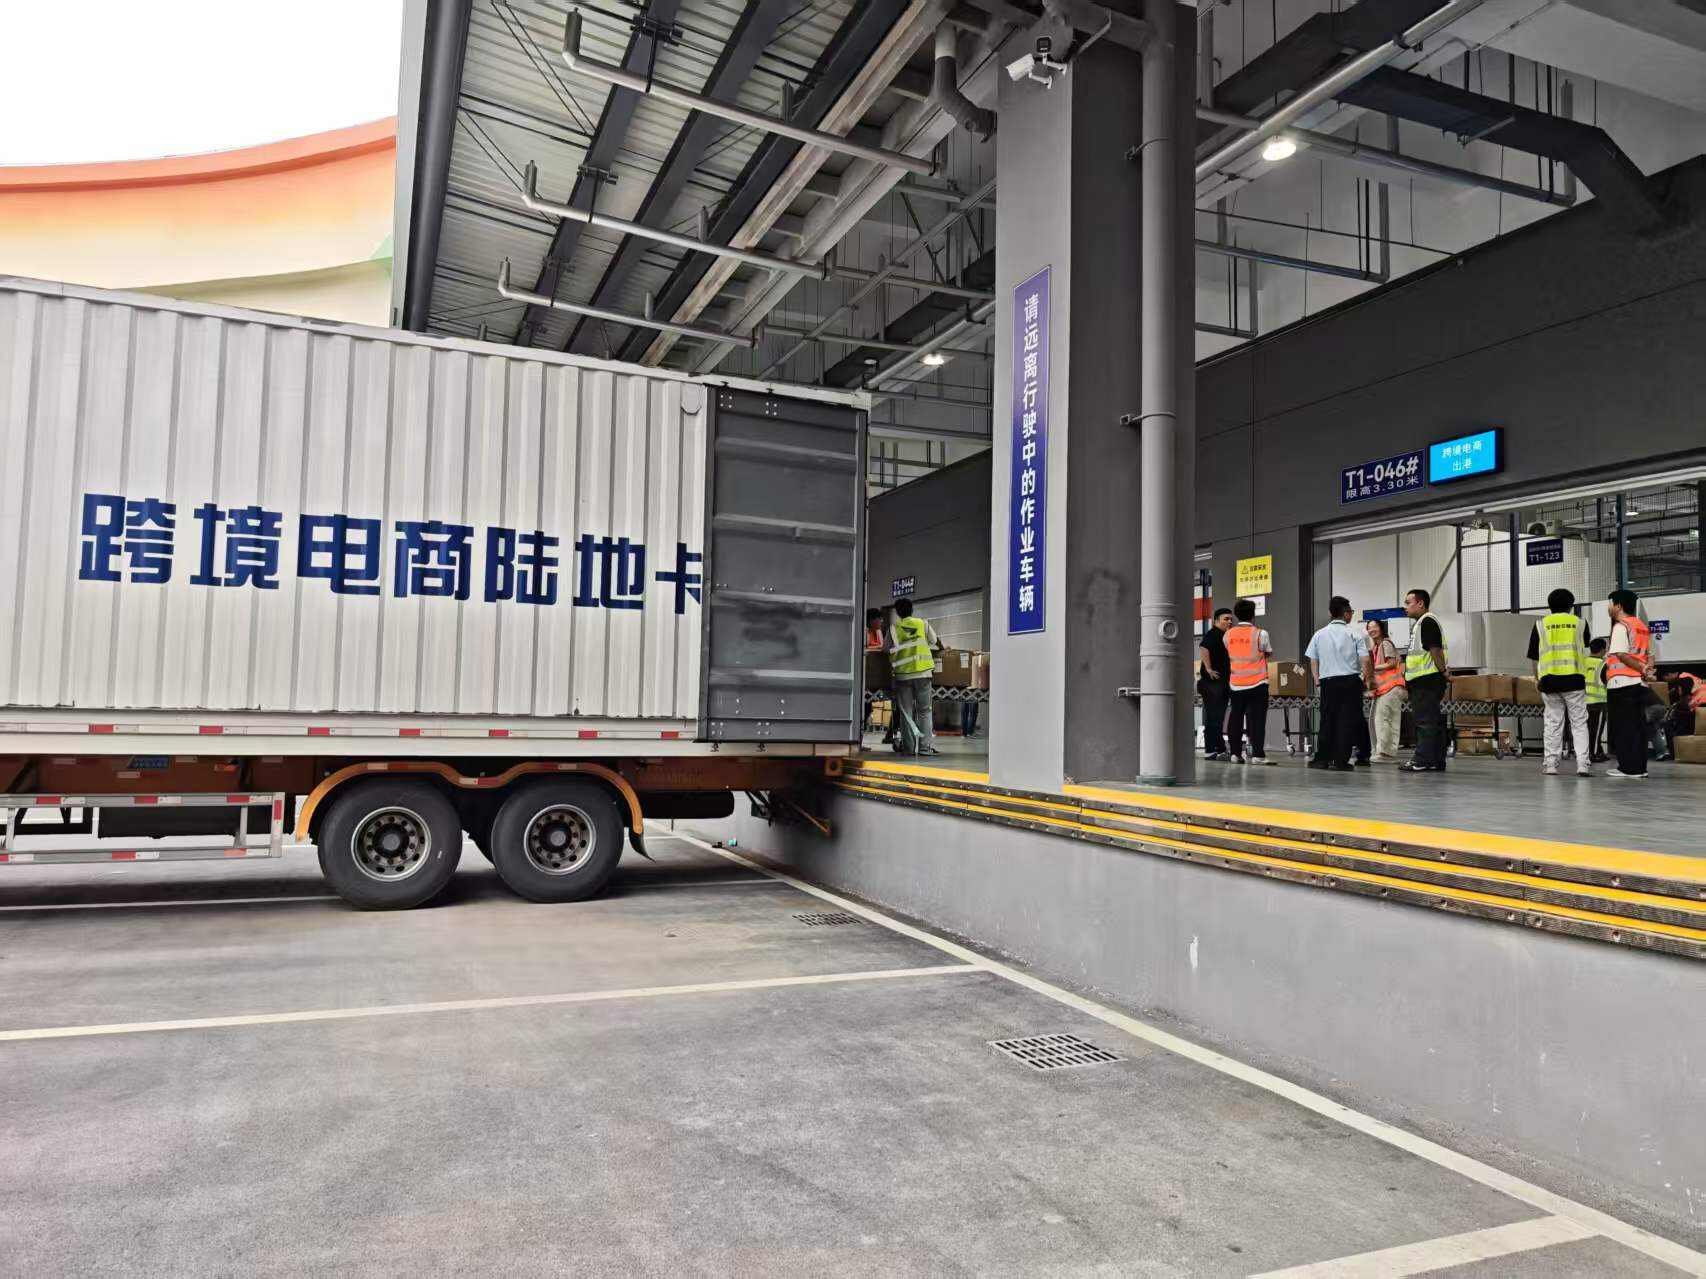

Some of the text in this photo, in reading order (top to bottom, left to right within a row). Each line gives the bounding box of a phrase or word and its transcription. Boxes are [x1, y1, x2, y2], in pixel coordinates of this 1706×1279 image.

[1018, 293, 1039, 613] 请远离行驶中的作业车辆
[1441, 440, 1483, 459] 跨境电商
[1345, 455, 1419, 489] T1-046#
[1452, 457, 1473, 472] 出港
[1345, 476, 1420, 500] 限高3.30米
[1528, 551, 1560, 563] T1-123
